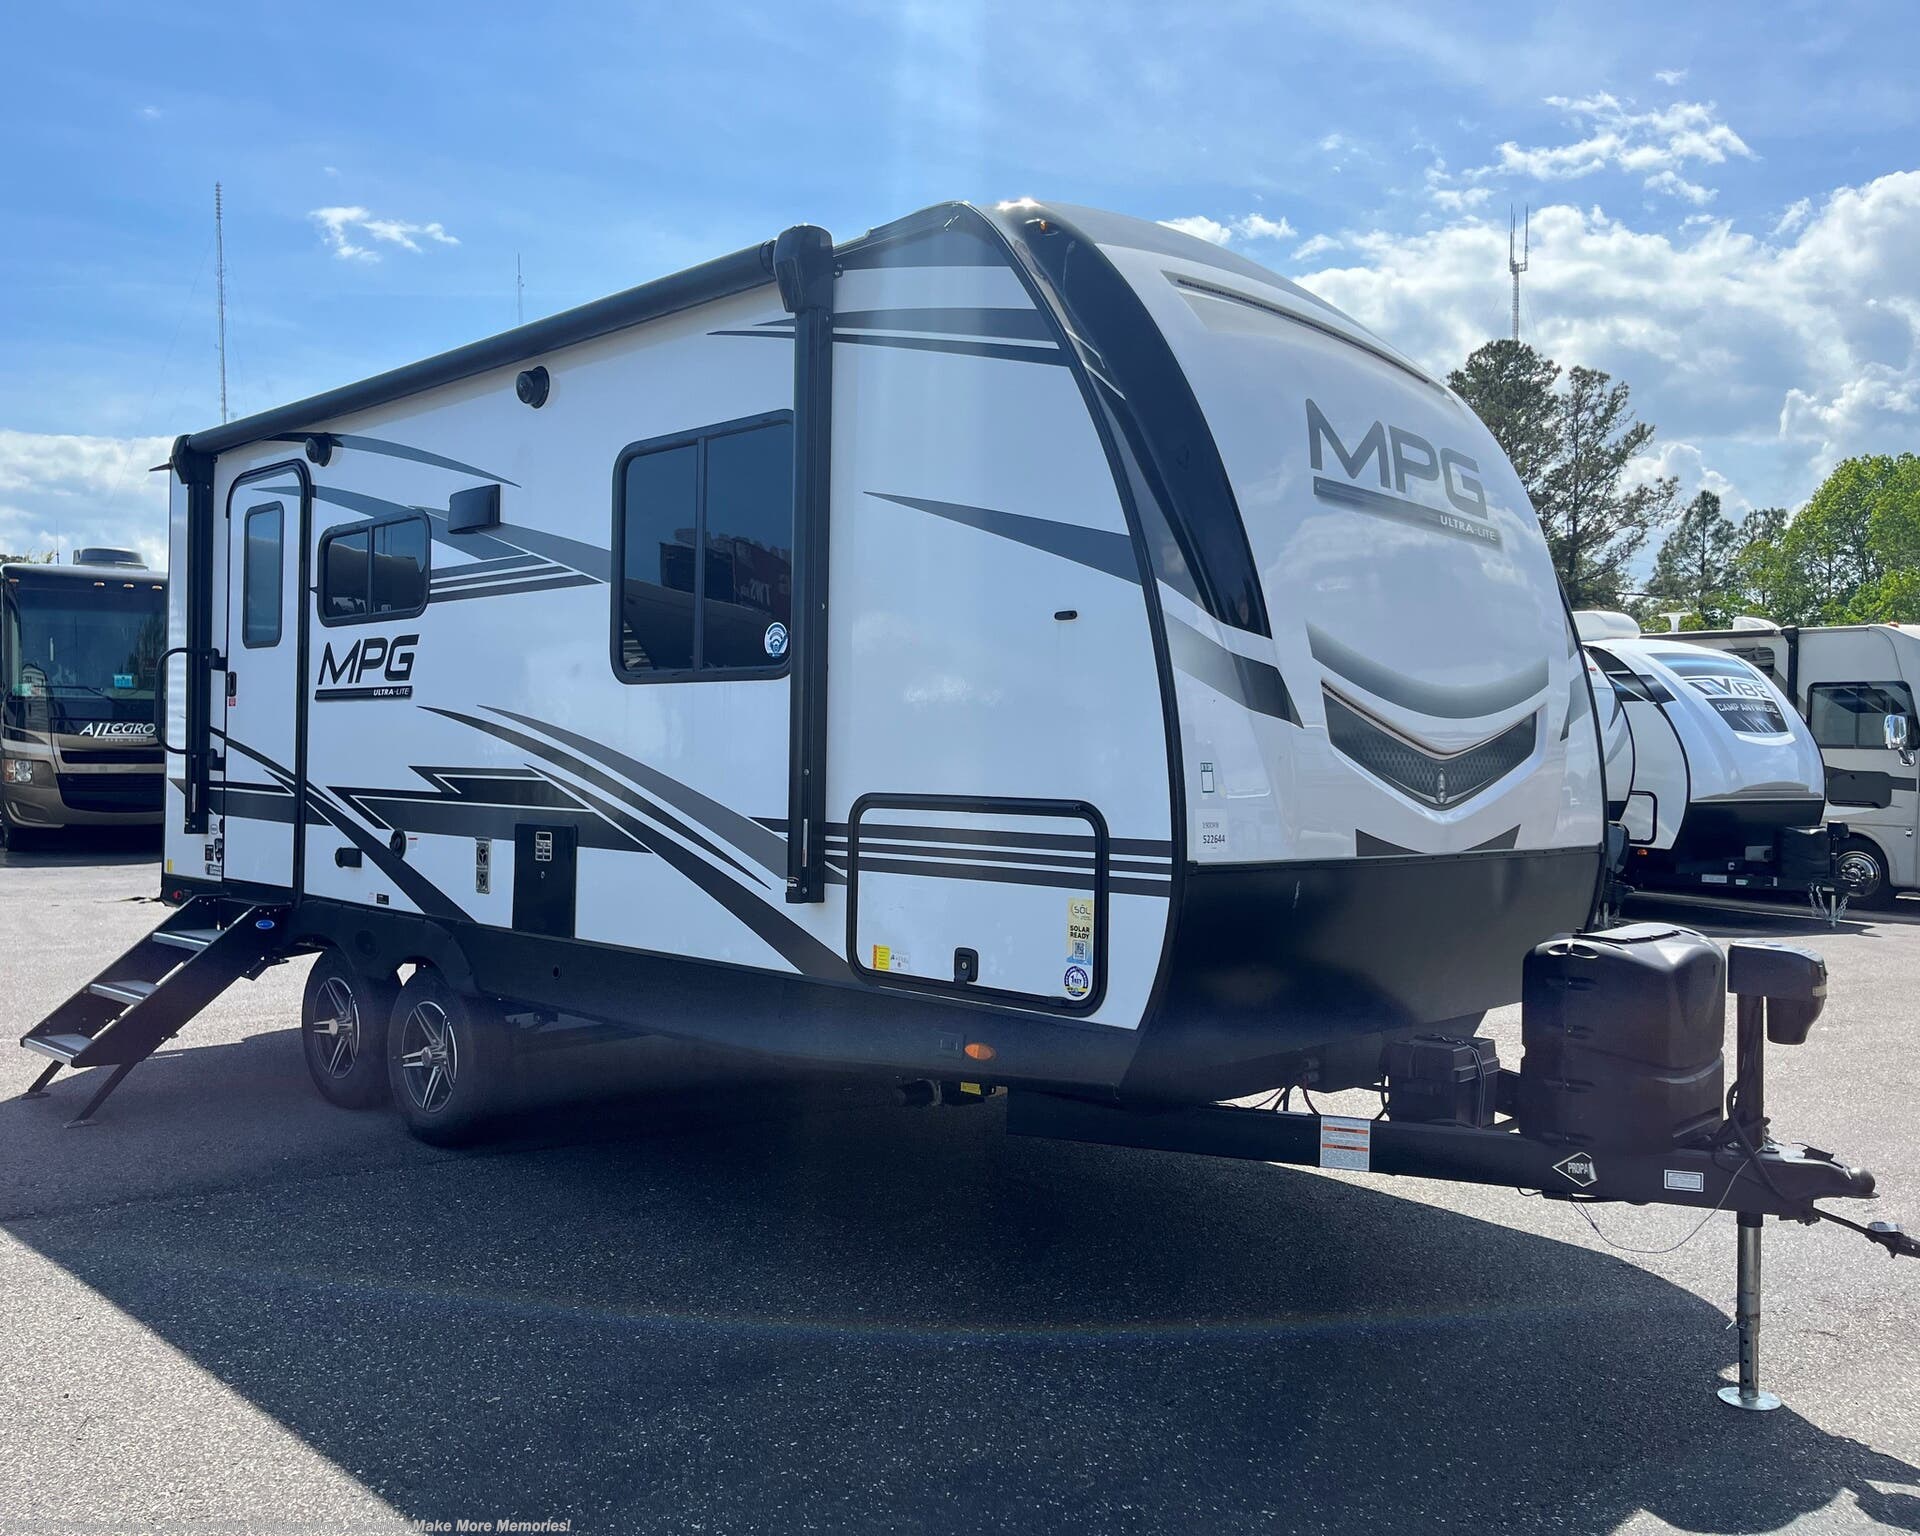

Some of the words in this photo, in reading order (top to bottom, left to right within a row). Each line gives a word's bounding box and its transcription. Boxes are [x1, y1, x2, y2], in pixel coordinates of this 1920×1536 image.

[1305, 398, 1488, 520] MPG
[1439, 515, 1497, 541] ULTRA-LITE
[318, 634, 420, 686] MPG
[373, 687, 410, 696] ULTRA-LITE
[1705, 678, 1772, 699] VIBE
[1716, 703, 1740, 712] CAMP
[79, 722, 157, 739] ALLEGRO
[1202, 834, 1226, 844] 522644
[1070, 925, 1090, 933] SOLAR
[1070, 931, 1090, 940] READY
[1567, 1162, 1590, 1175] PROPA
